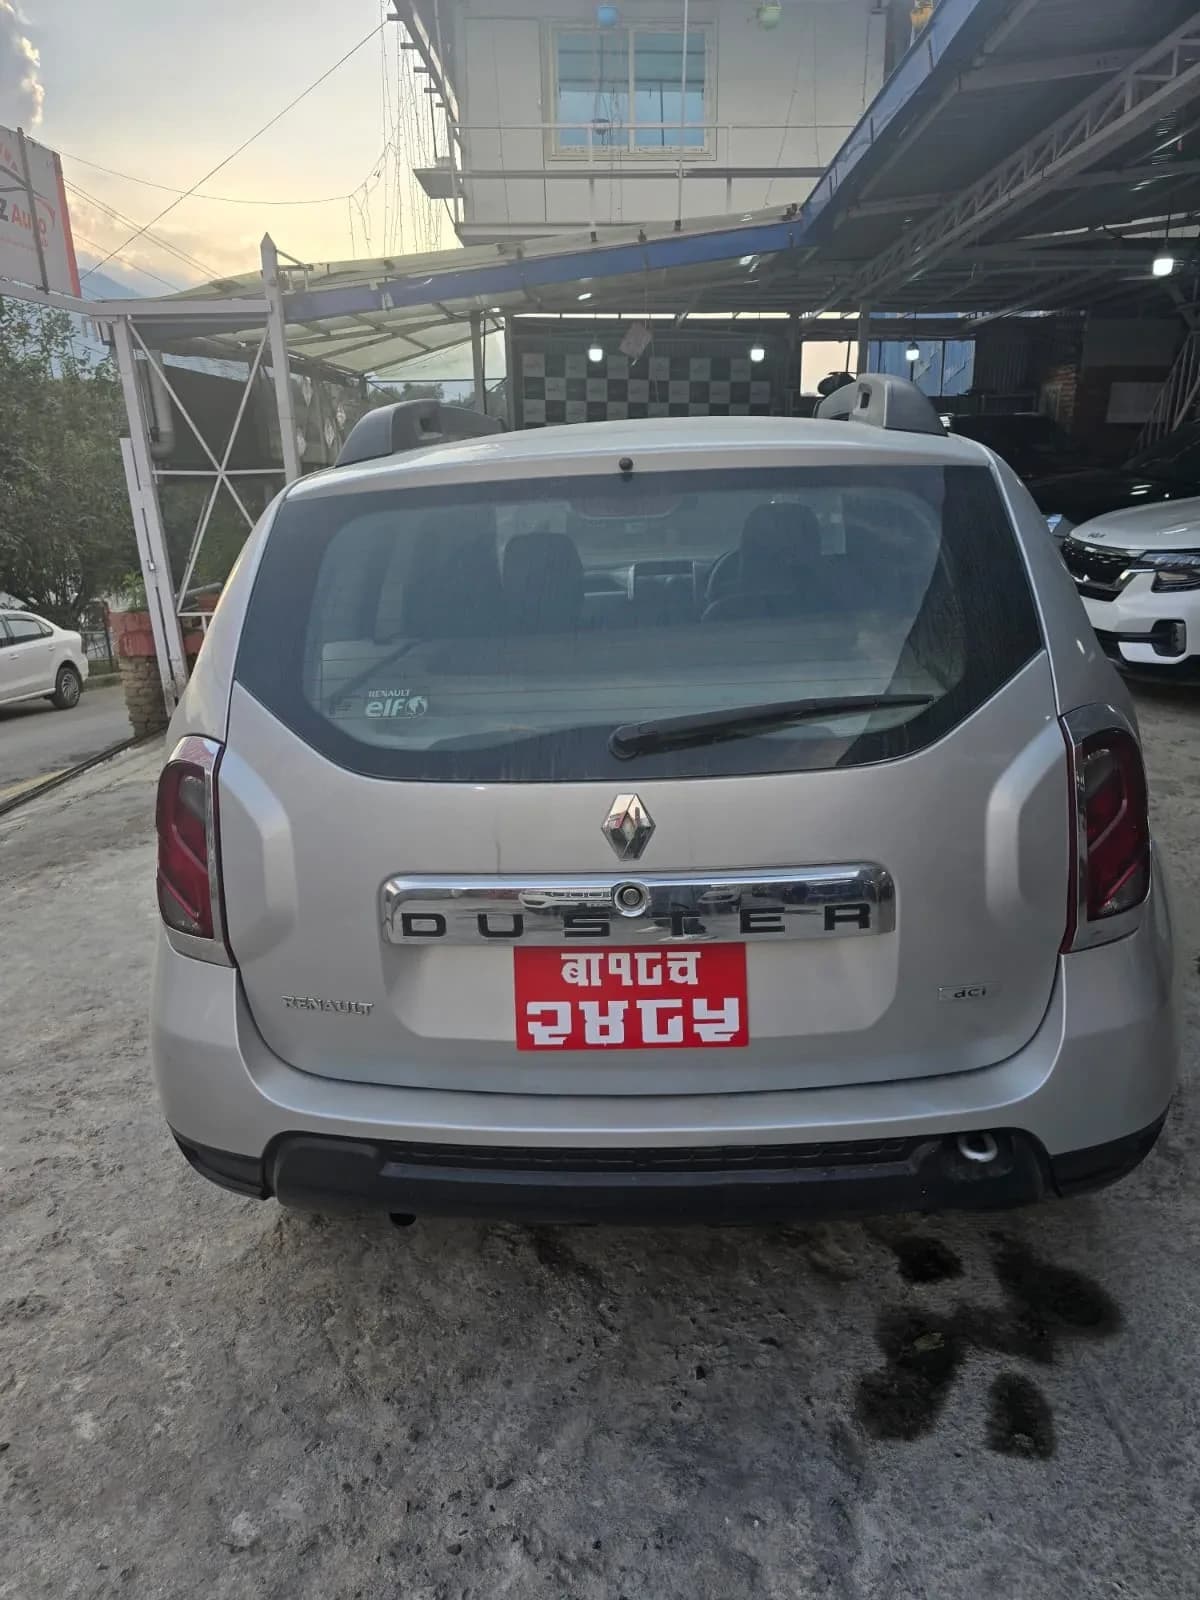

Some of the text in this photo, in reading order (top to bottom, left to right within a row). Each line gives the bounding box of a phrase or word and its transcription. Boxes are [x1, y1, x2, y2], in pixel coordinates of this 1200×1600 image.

[11, 203, 48, 234] Auo
[368, 688, 412, 698] RENAULT
[365, 698, 405, 718] elf
[401, 903, 872, 939] DUSTER
[281, 994, 375, 1016] RENAULT
